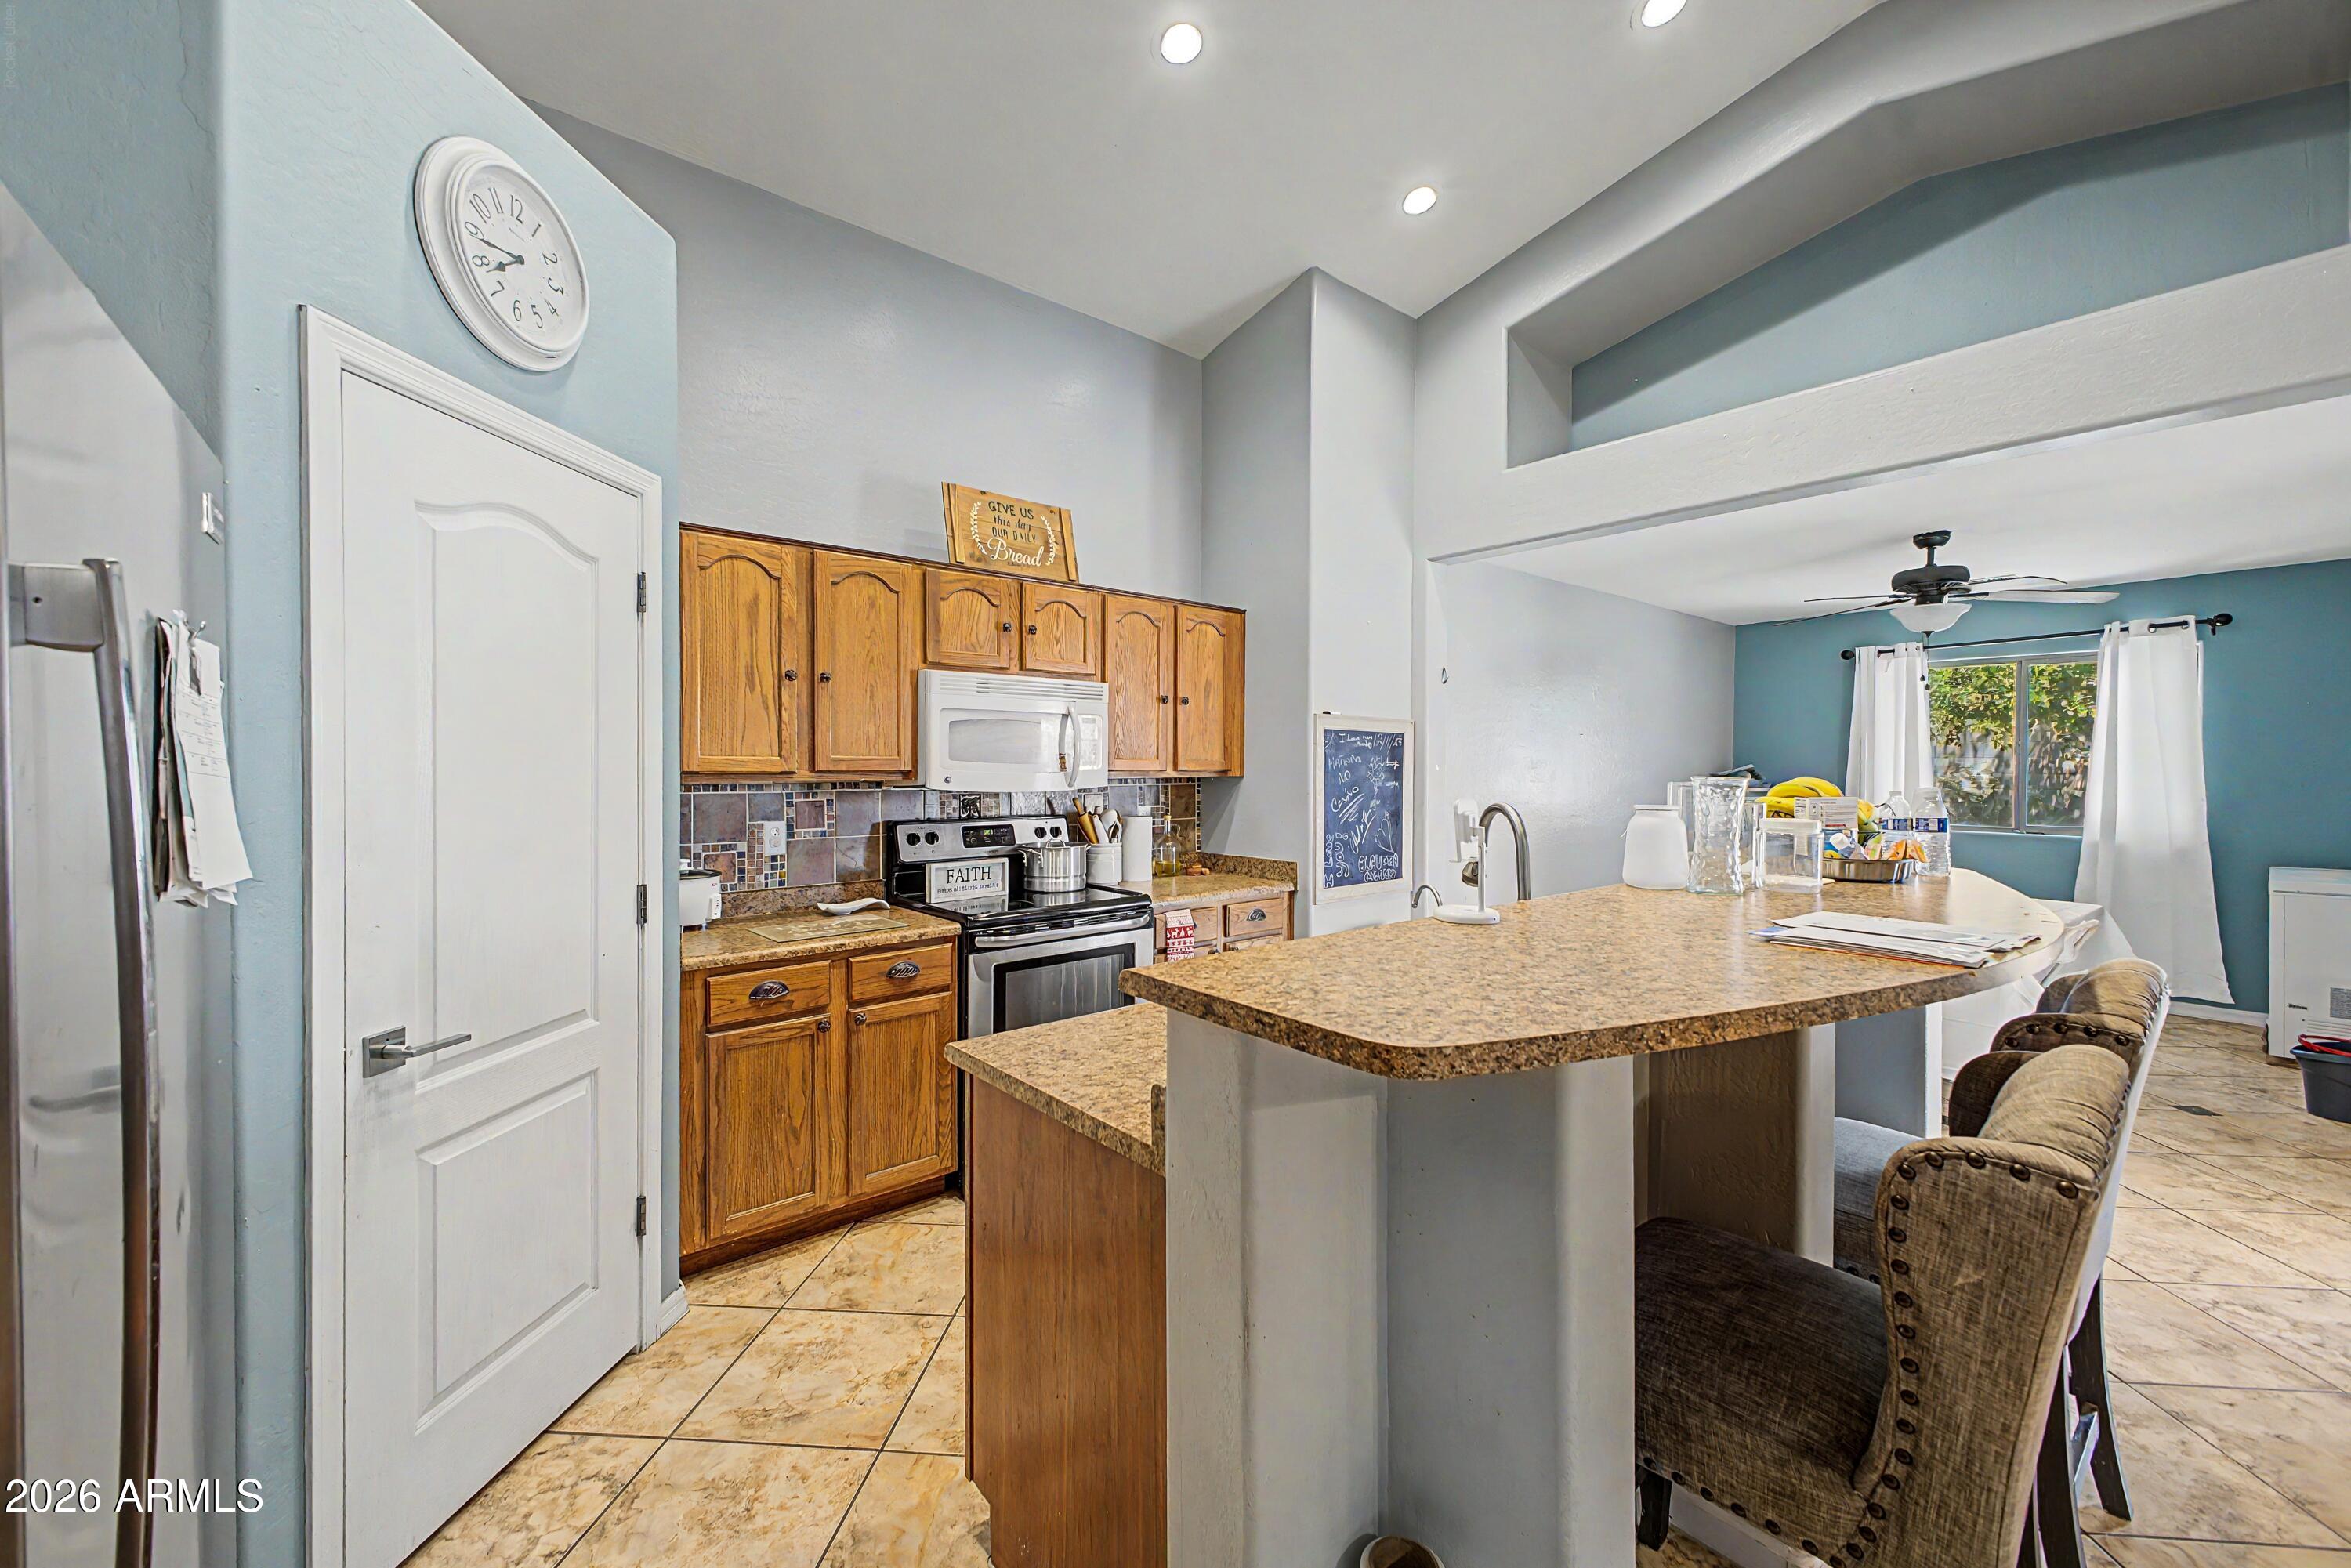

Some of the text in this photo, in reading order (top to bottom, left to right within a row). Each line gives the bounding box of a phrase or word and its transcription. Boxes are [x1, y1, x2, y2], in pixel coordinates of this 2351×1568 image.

[469, 194, 491, 224] 10
[488, 188, 504, 214] 11
[510, 195, 524, 224] 12
[465, 222, 484, 240] 9
[532, 223, 542, 237] 1
[472, 255, 490, 267] 8
[542, 253, 558, 266] 2
[491, 281, 505, 297] 7
[548, 277, 564, 296] 3
[513, 300, 522, 321] 6
[531, 304, 543, 328] 5
[544, 298, 559, 317] 4
[988, 501, 1034, 520] GIVE US
[992, 527, 1036, 543] OUR DAILY
[987, 537, 1045, 567] Bread
[946, 866, 992, 884] FAITH
